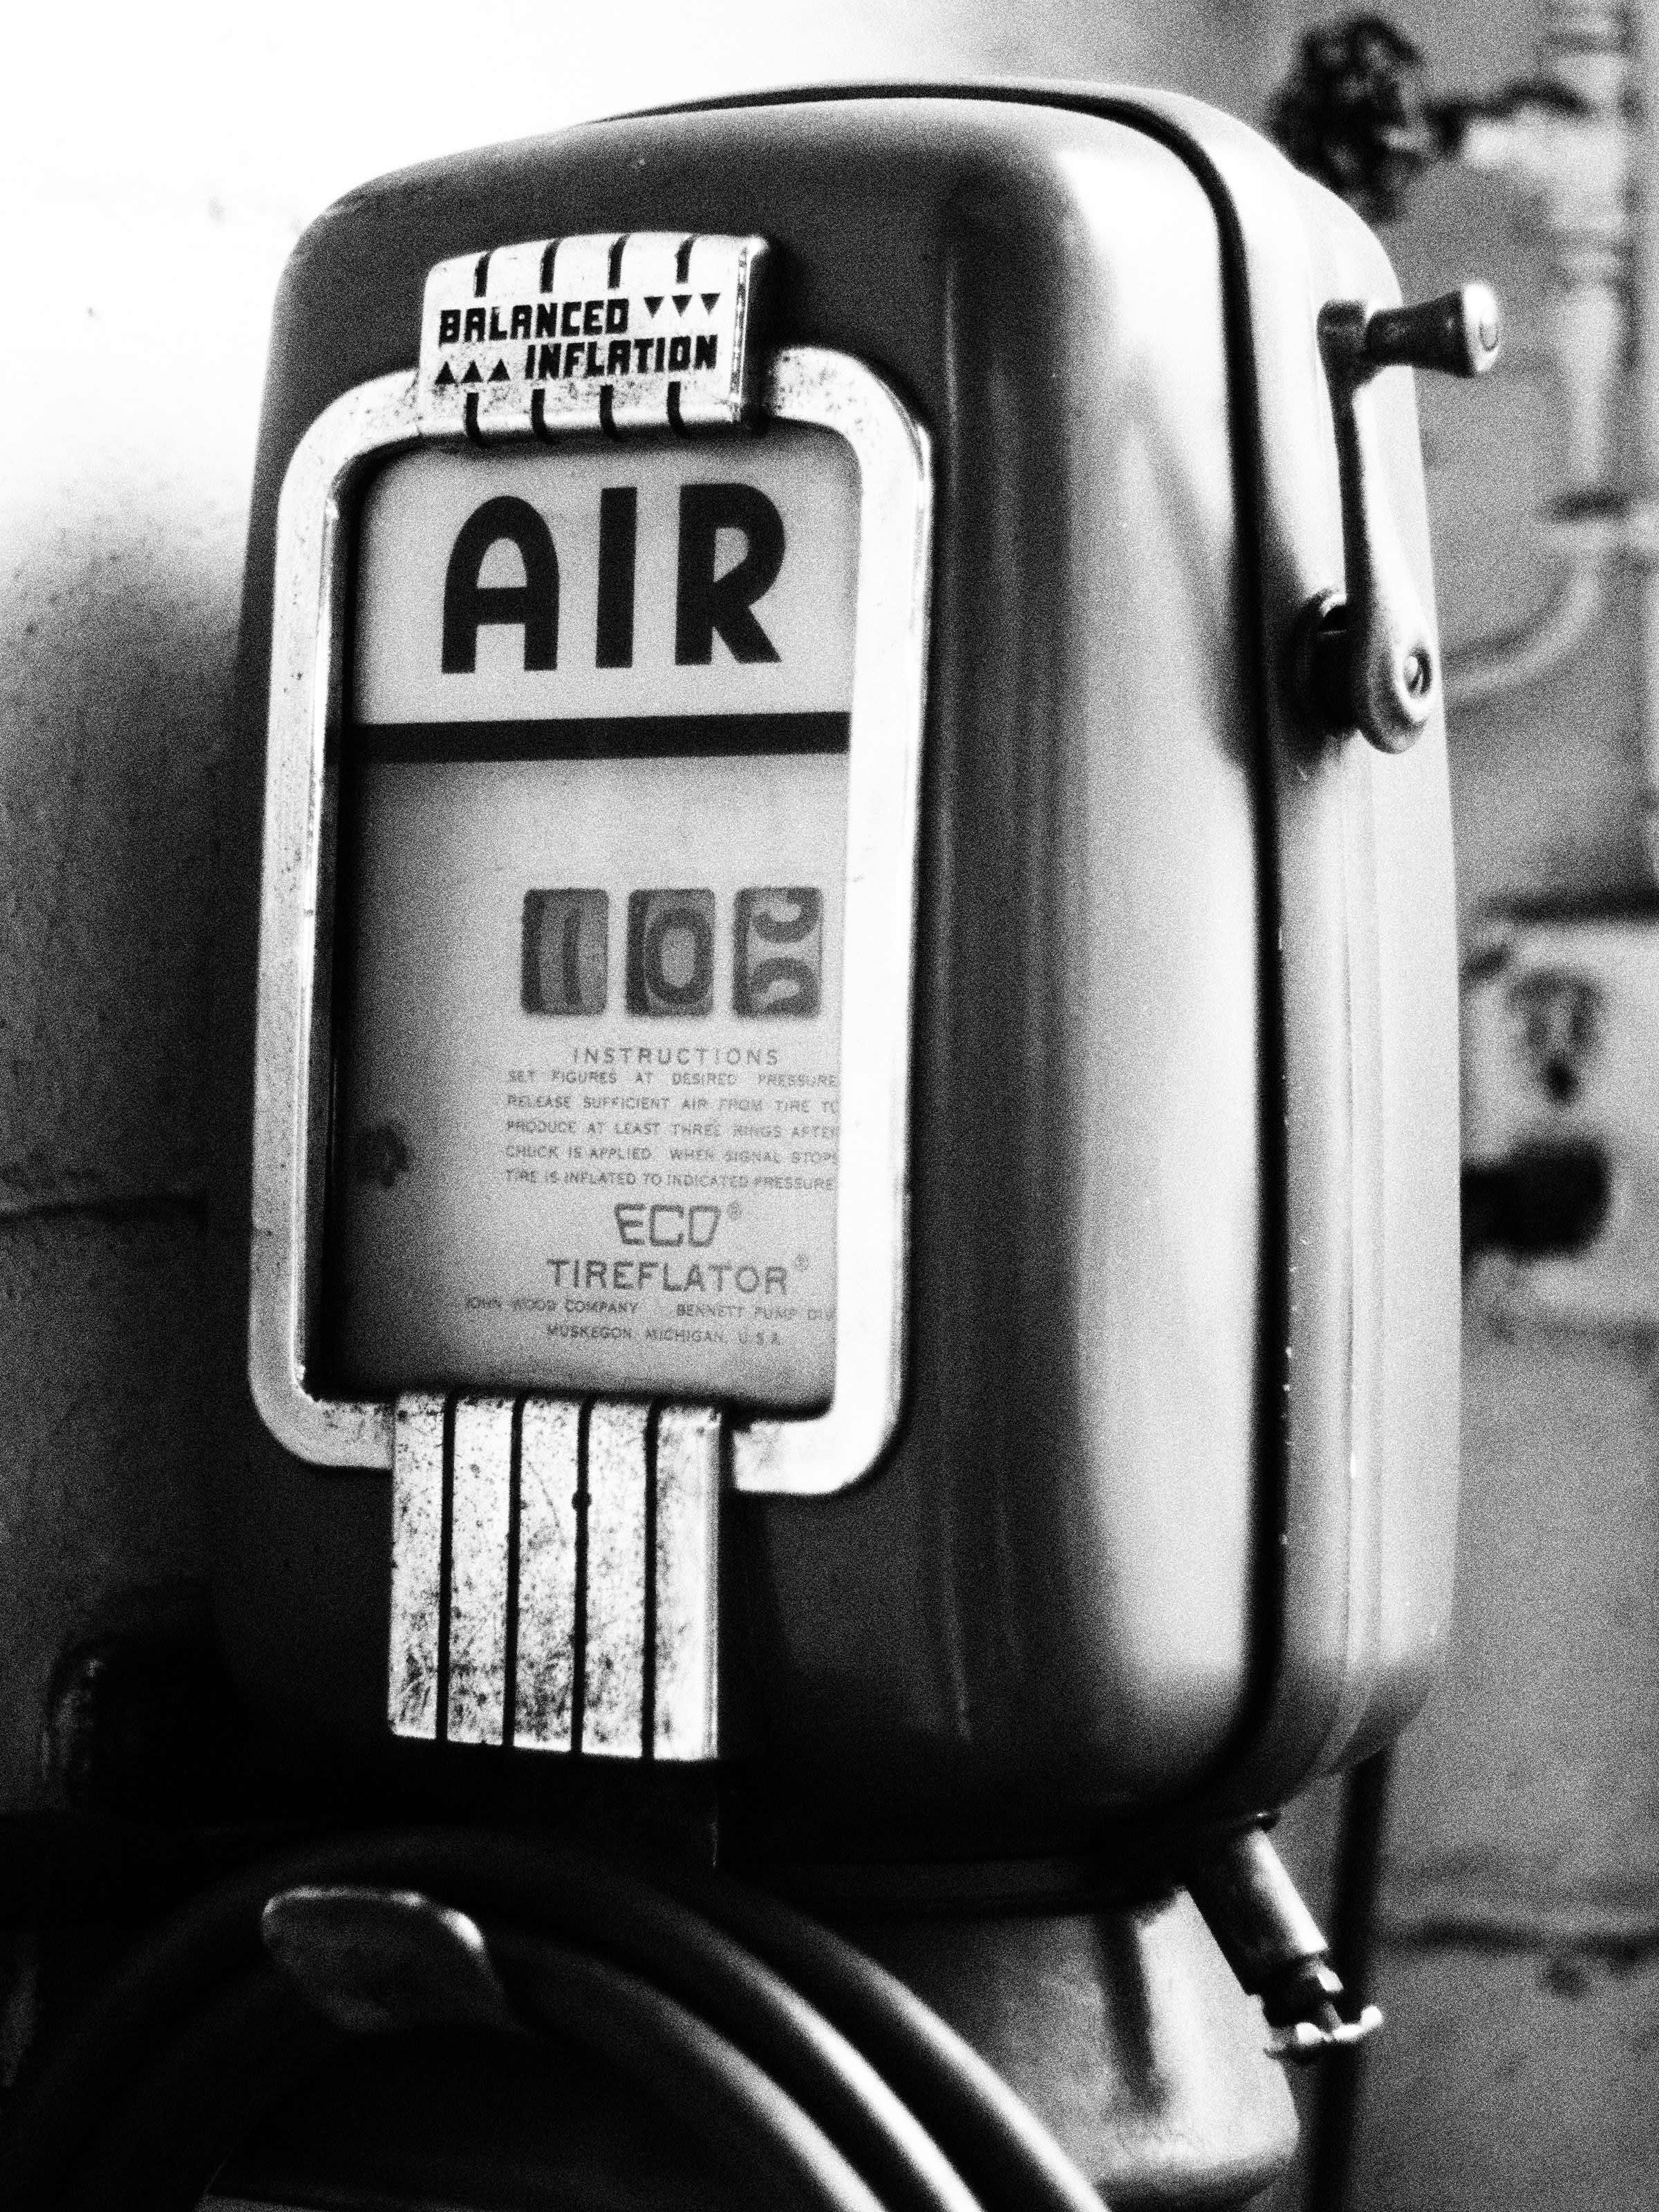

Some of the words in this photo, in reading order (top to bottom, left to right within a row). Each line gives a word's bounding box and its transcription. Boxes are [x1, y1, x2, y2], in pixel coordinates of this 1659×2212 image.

[438, 298, 629, 347] BALANCED
[524, 335, 719, 379] INFLATION
[441, 483, 785, 674] AIR
[572, 1046, 778, 1066] INSTRUCTIONS
[508, 1069, 536, 1084] SET
[552, 1069, 617, 1085] FIGURES
[635, 1071, 654, 1085] AT
[672, 1073, 738, 1086] DESIRED
[507, 1094, 571, 1109] RELEASE
[583, 1096, 671, 1110] SUFFICIENT
[681, 1098, 709, 1110] AIR
[718, 1098, 763, 1112] FROM
[775, 1099, 810, 1114] TIRE
[506, 1120, 577, 1134] PRODUCE
[588, 1122, 605, 1135] AT
[614, 1122, 661, 1136] LEAST
[671, 1123, 721, 1137] THREE
[568, 1146, 582, 1159] IS
[669, 1147, 715, 1162] WHEN
[724, 1150, 780, 1164] SIGNAL
[543, 1171, 559, 1184] IS
[564, 1171, 637, 1185] INFLATED
[641, 1173, 663, 1186] TO
[667, 1174, 749, 1189] INDICATED
[564, 1297, 639, 1314] COMPANY
[676, 1304, 744, 1318] BENNETT
